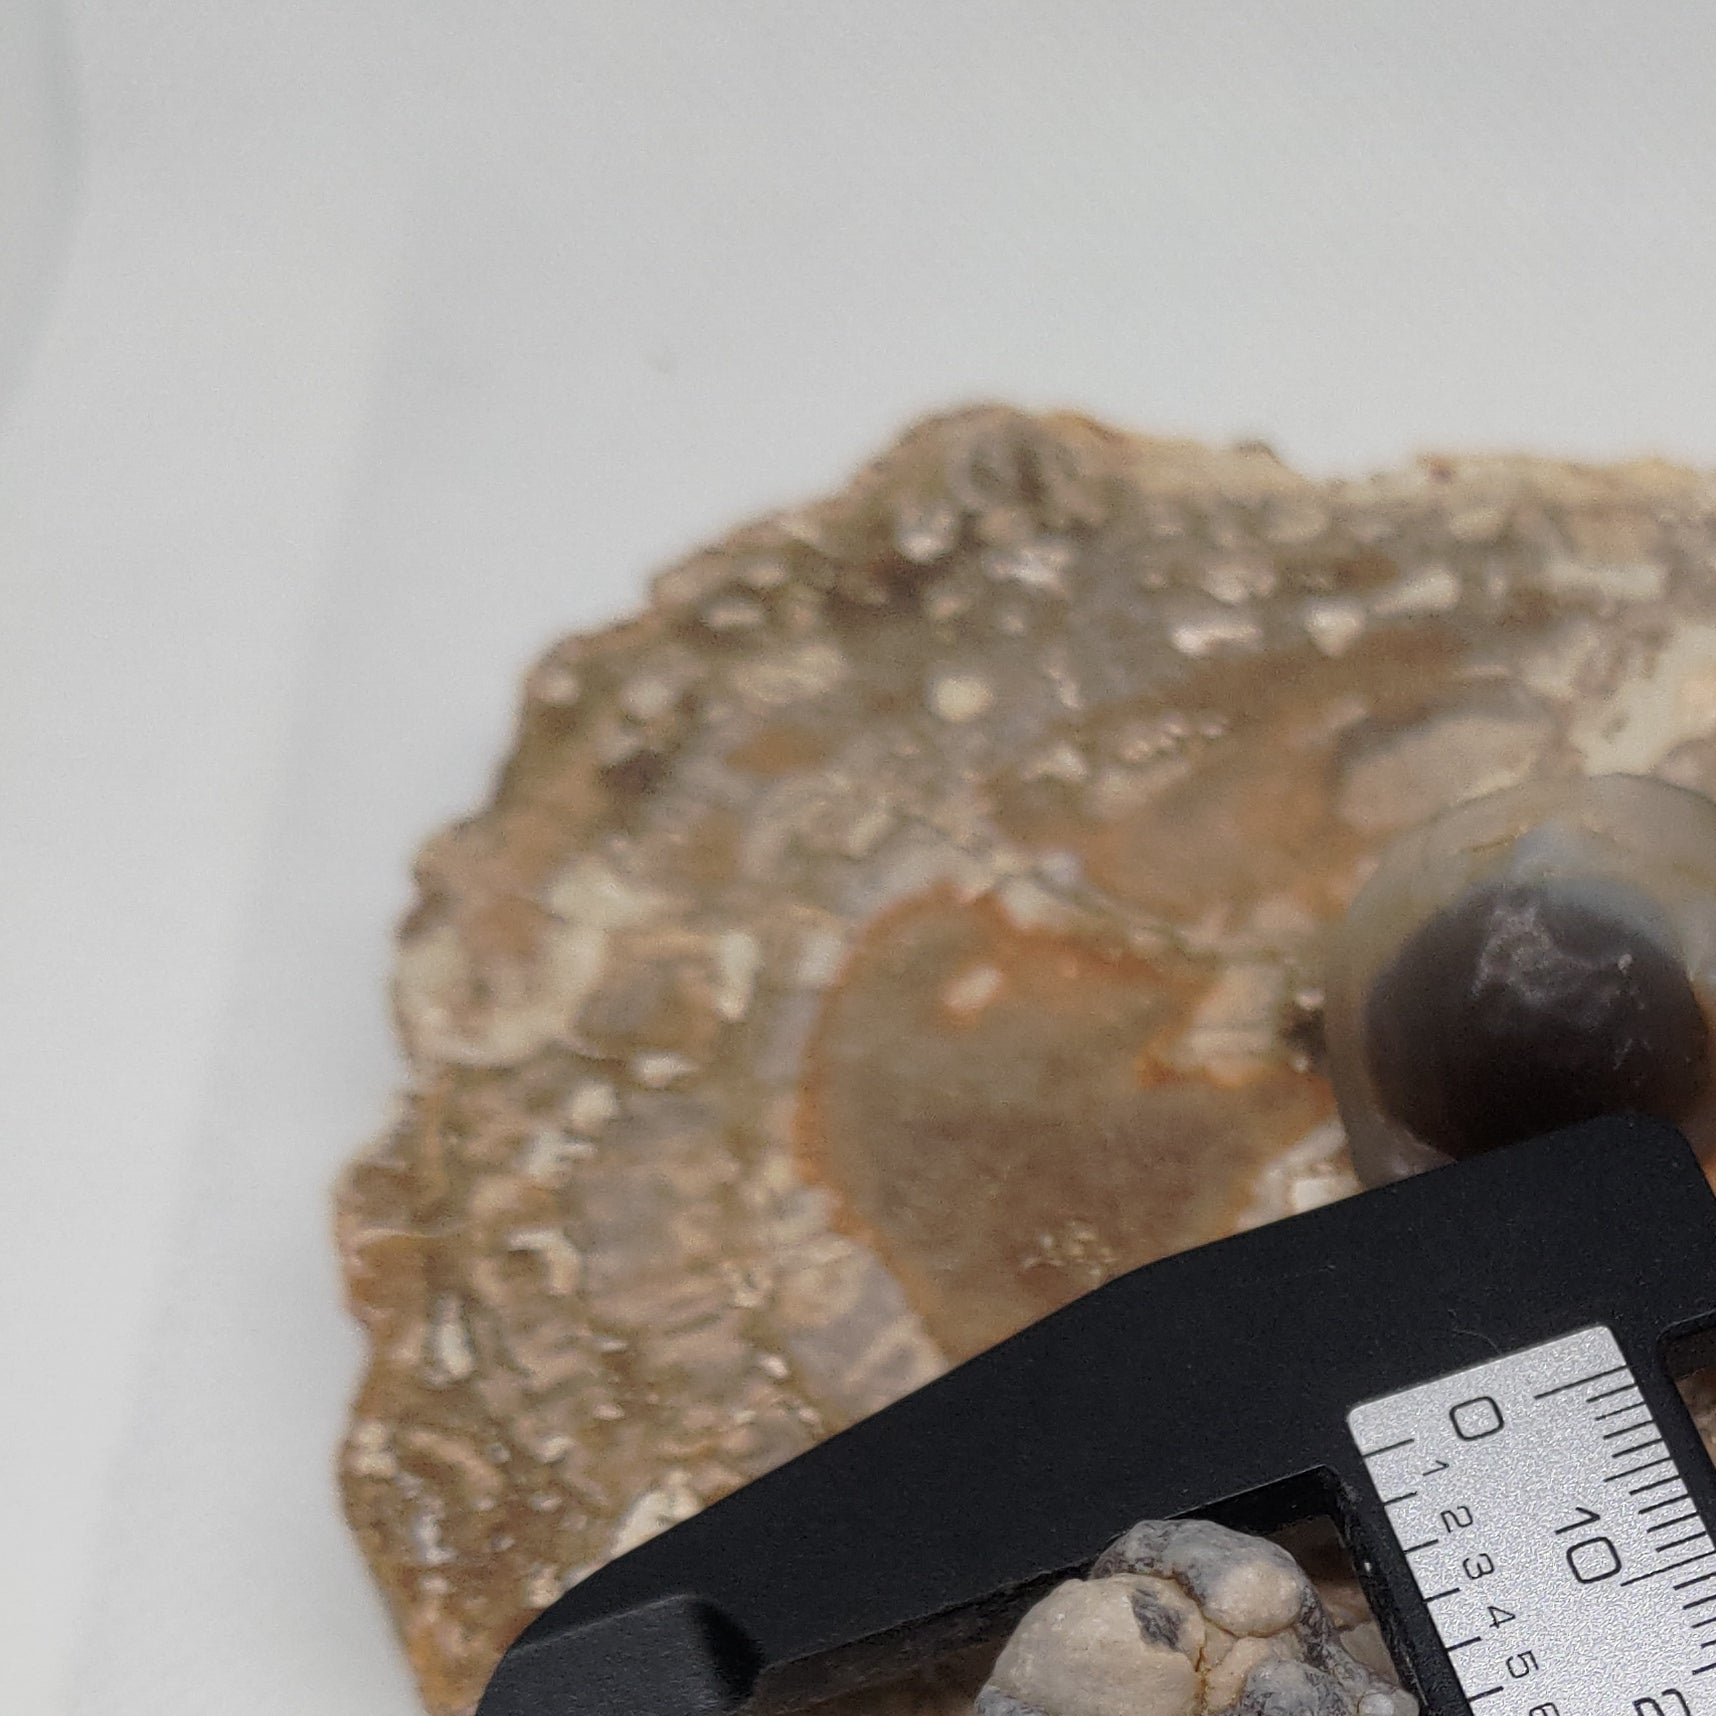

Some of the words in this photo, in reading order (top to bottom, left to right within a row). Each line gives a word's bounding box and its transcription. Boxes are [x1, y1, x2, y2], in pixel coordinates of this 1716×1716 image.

[1422, 1458, 1449, 1478] 1
[1440, 1504, 1474, 1533] 2
[1462, 1552, 1495, 1579] 3
[1486, 1604, 1517, 1629] 4
[1506, 1650, 1540, 1680] 5
[1449, 1395, 1504, 1441] 0
[1554, 1506, 1622, 1583] 10
